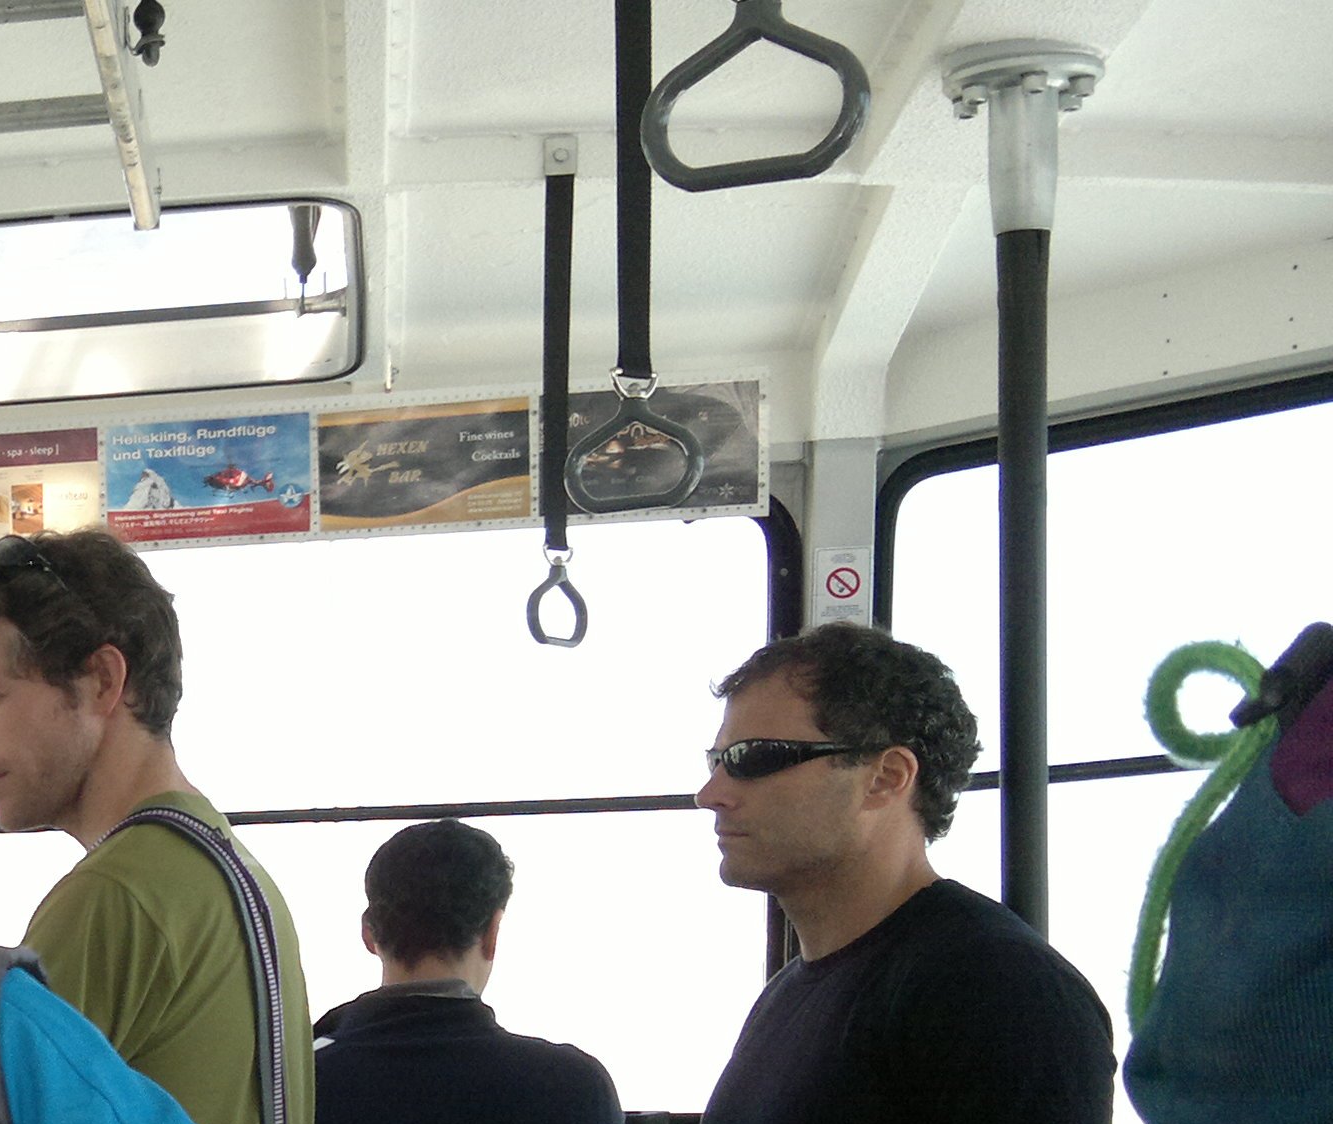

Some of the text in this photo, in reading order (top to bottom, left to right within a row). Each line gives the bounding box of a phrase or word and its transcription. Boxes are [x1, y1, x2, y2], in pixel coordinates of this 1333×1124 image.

[196, 424, 277, 439] Rundflüge
[459, 430, 515, 443] Fine wines
[7, 449, 23, 458] spa
[30, 446, 53, 456] sleep
[112, 444, 216, 461] und Taxiflüge
[376, 440, 429, 456] HEXEN
[471, 448, 521, 462] Cocktails
[388, 469, 422, 483] BAR
